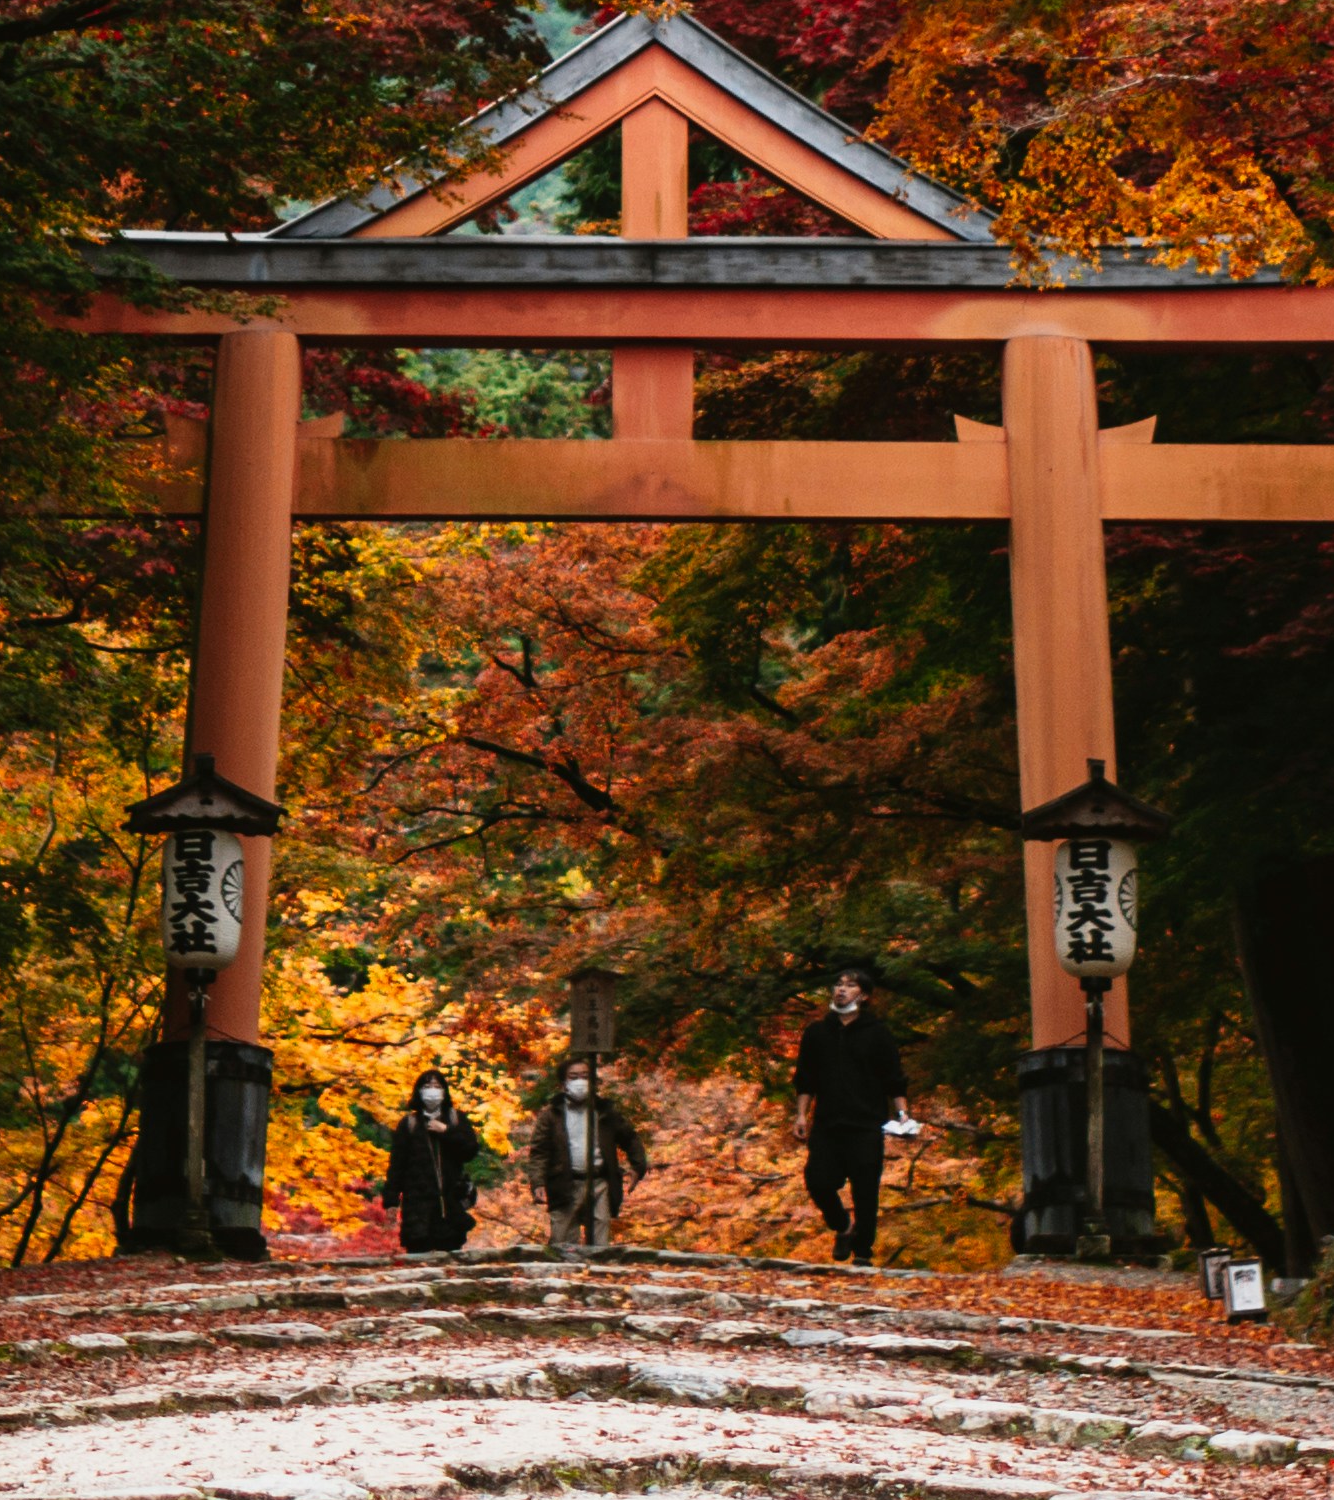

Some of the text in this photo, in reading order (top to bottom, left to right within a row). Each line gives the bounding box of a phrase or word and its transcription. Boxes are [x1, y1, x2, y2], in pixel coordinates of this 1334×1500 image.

[168, 830, 219, 955] 日吉大社
[1066, 841, 1115, 964] 日吉大社
